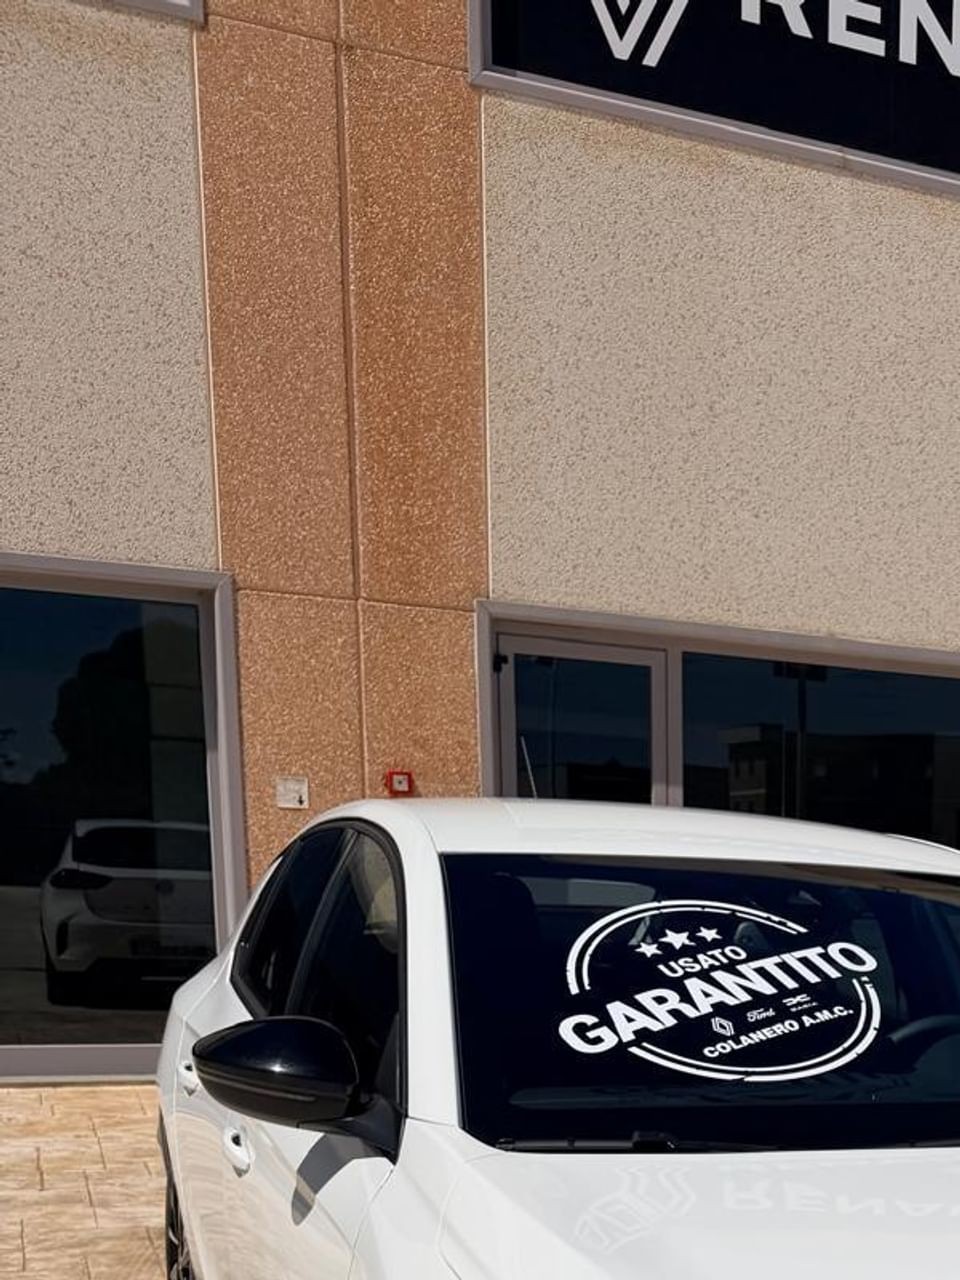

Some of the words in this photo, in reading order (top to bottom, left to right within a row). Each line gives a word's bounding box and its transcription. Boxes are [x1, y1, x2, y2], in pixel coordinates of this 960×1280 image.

[657, 945, 747, 978] USATO
[558, 941, 878, 1054] GARANTITO
[702, 1019, 800, 1058] COLANERO
[801, 1006, 855, 1028] A.M.C.
